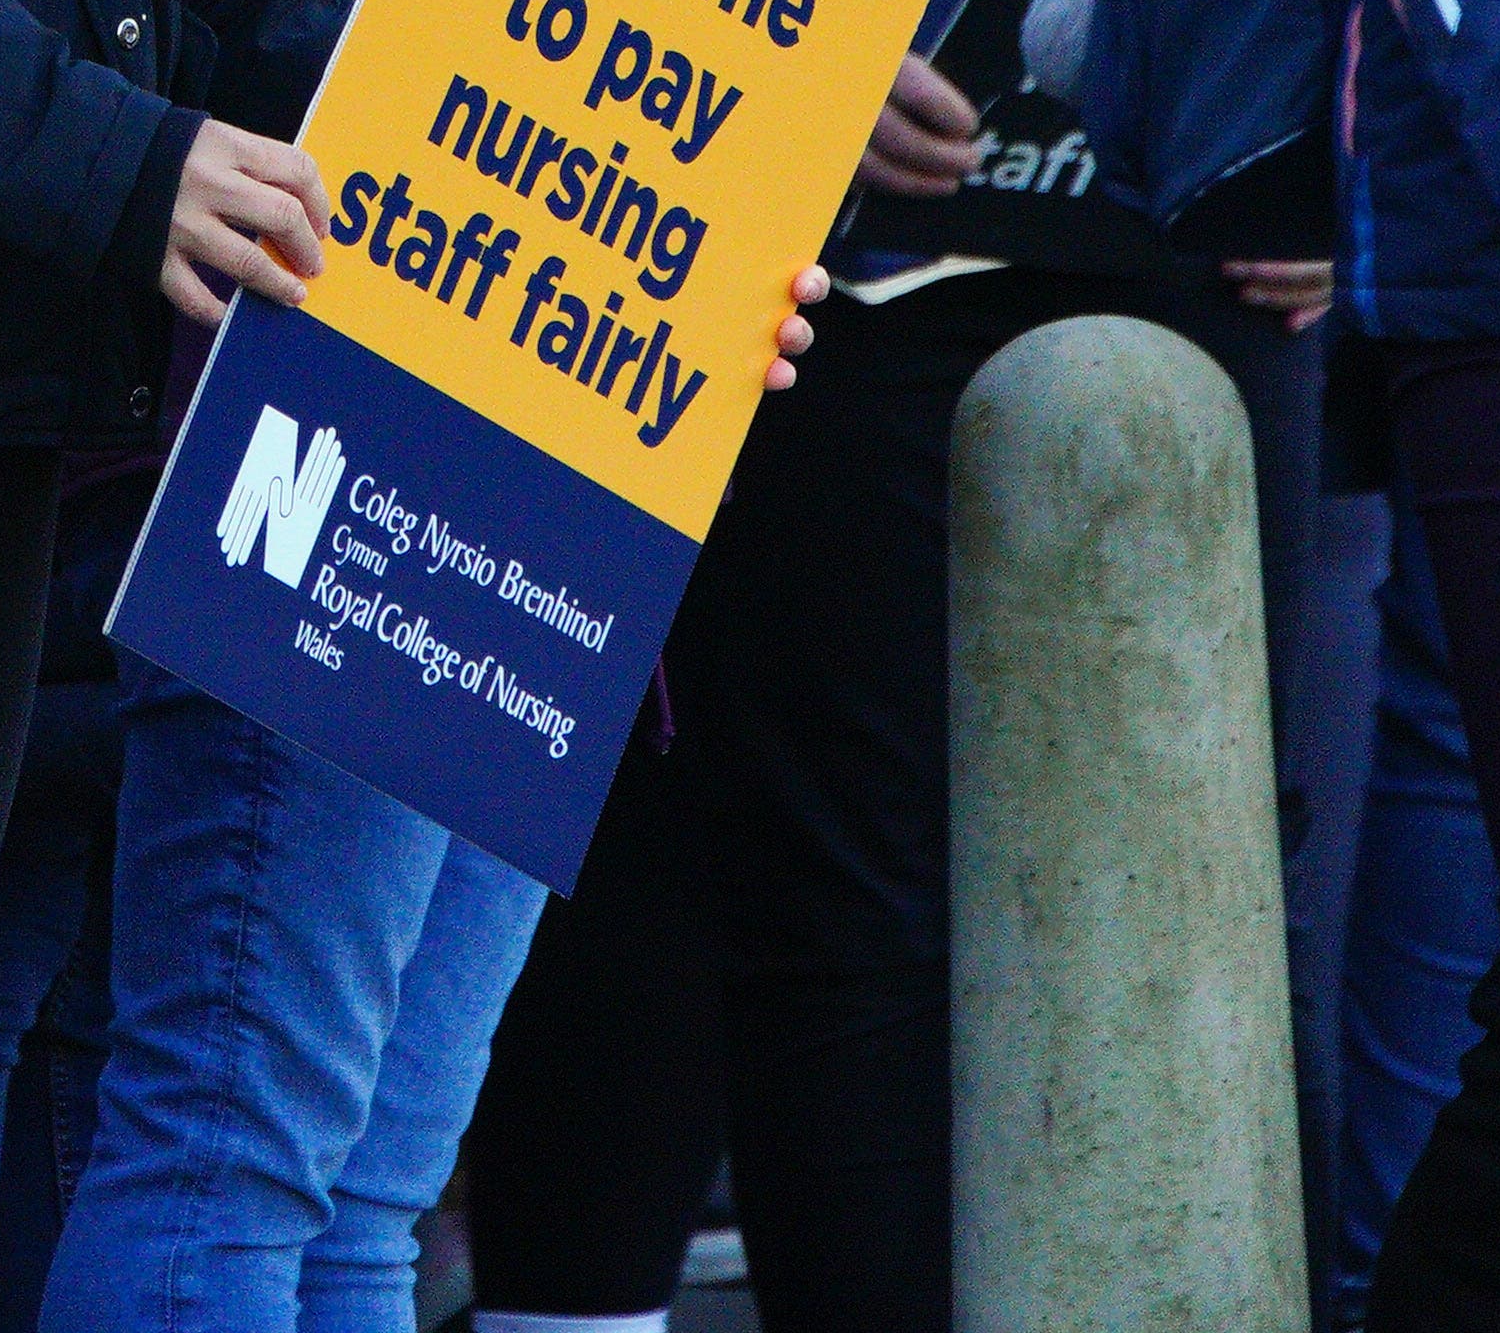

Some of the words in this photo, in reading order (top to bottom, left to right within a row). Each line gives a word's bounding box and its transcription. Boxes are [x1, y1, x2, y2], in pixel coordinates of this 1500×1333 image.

[584, 19, 743, 164] pay
[427, 74, 708, 301] nursing
[329, 171, 521, 320] staff
[510, 255, 708, 448] fairly
[332, 524, 389, 576] Cymru
[349, 474, 418, 554] Coleg
[418, 513, 496, 586] Nyrsio
[498, 559, 614, 653] Brenhinol
[294, 619, 344, 671] Wales
[311, 563, 383, 631] Royal
[377, 603, 461, 685] College
[459, 655, 495, 693] of
[486, 665, 576, 758] Nursing
